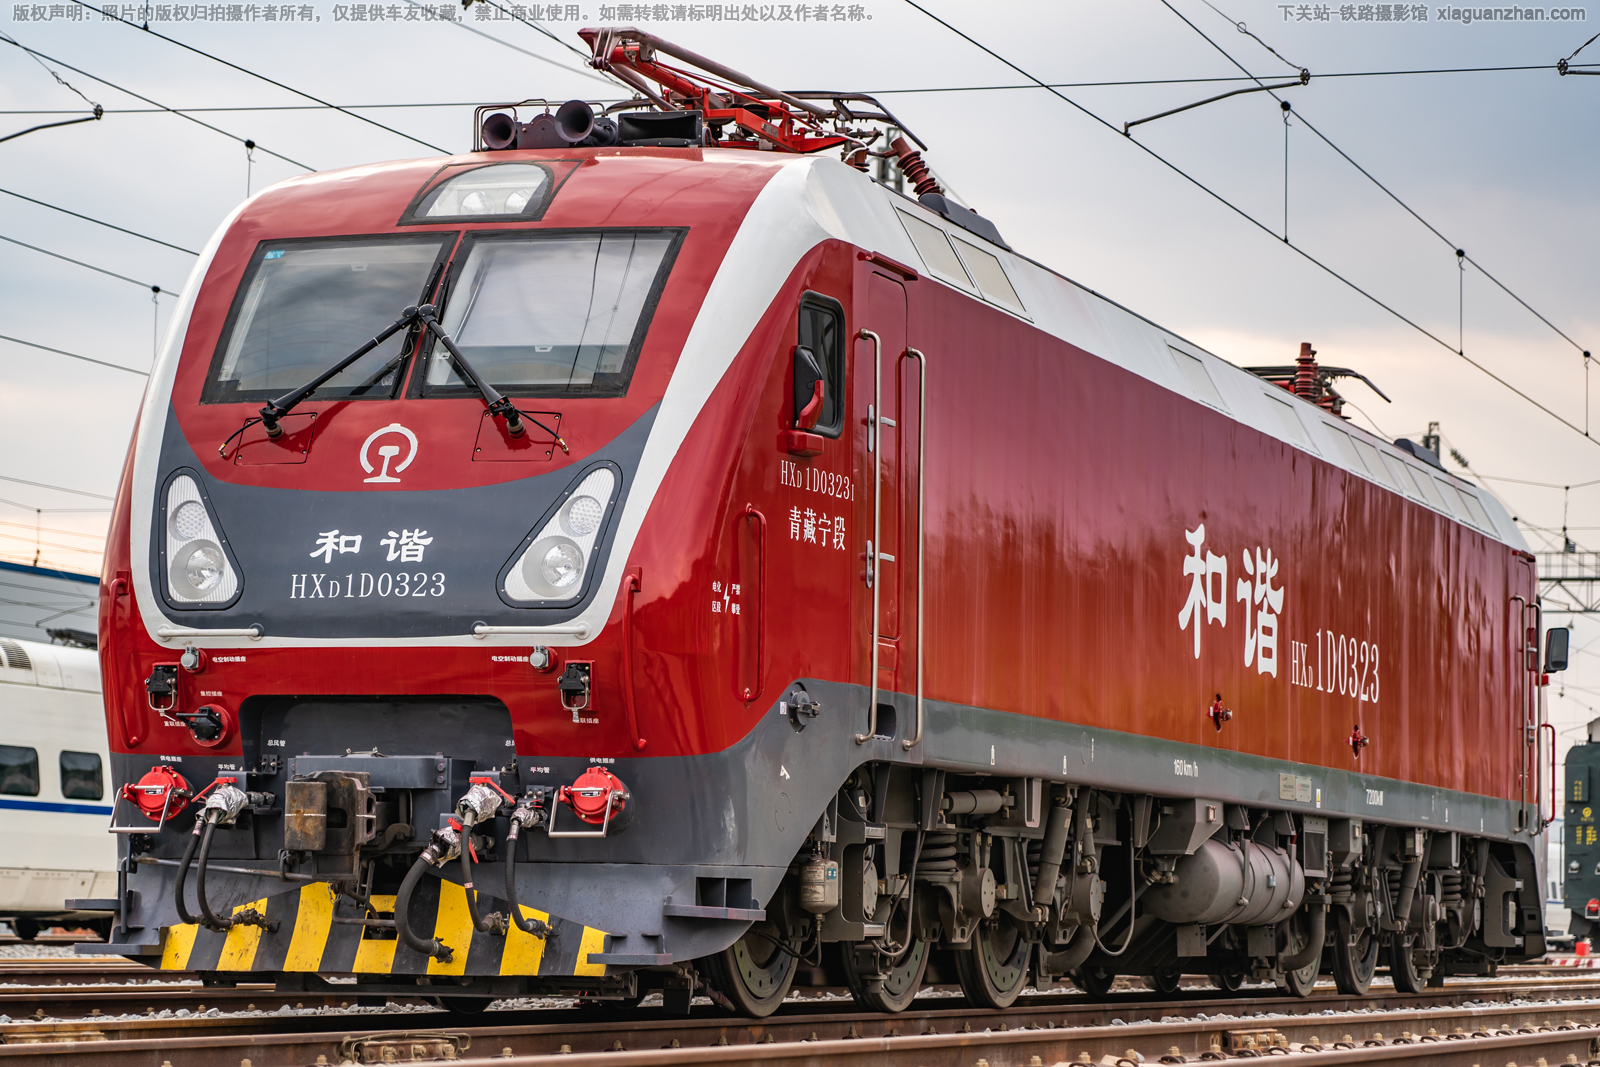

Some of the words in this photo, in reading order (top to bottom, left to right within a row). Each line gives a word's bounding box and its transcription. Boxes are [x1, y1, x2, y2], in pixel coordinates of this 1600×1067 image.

[309, 528, 434, 564] 和谐
[788, 505, 846, 551] 青藏宁段
[1178, 523, 1284, 679] 和谐
